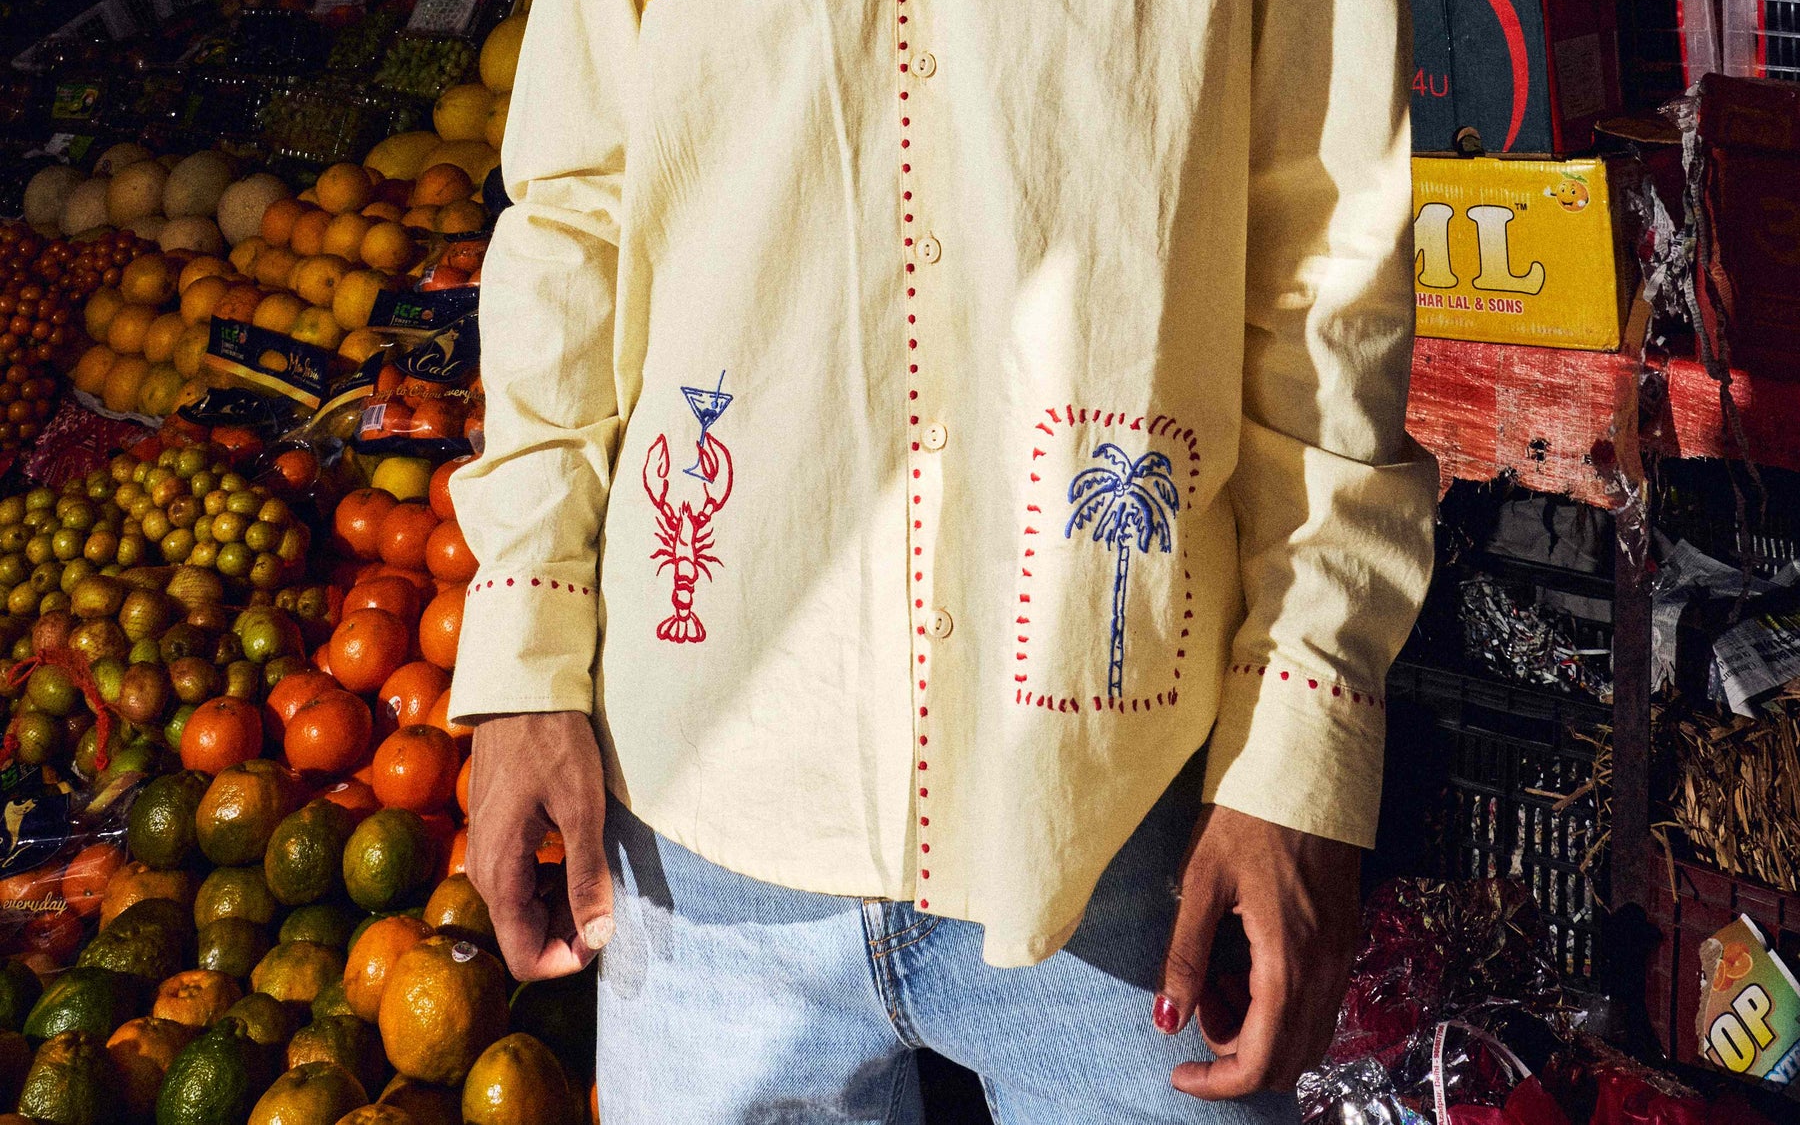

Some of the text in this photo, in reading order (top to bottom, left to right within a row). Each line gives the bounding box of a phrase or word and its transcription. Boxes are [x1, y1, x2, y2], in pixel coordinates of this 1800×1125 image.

[1415, 293, 1523, 314] HAR LAL & SONS
[1705, 983, 1777, 1074] OP
